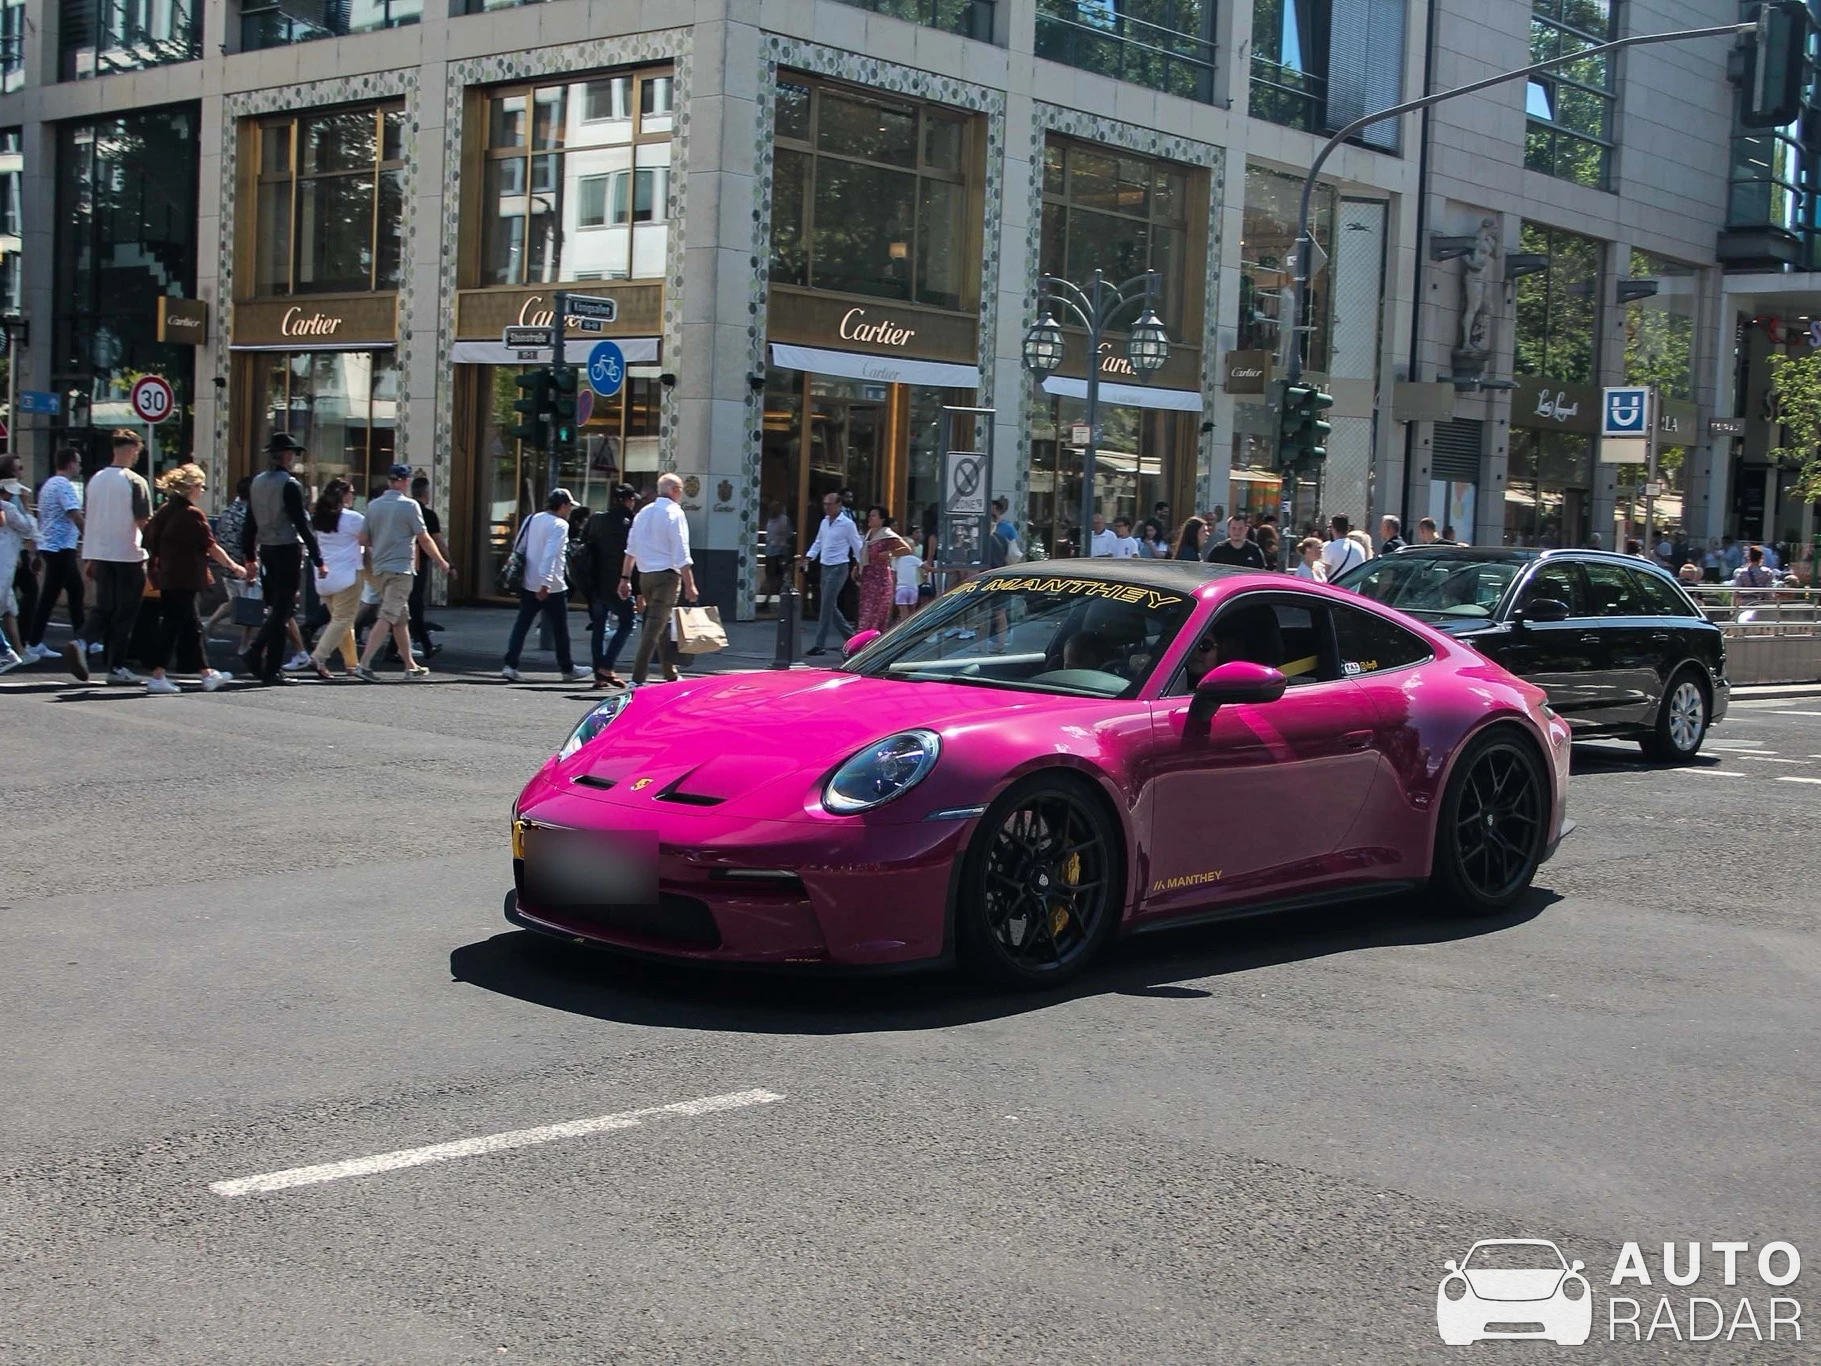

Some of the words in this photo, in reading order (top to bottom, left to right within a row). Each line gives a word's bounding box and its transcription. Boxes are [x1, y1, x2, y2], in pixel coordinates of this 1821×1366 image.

[167, 315, 201, 328] Cartier
[281, 307, 342, 336] Cartier
[519, 296, 580, 328] Care
[839, 307, 916, 346] Cartier
[861, 360, 901, 381] Cartier
[1231, 366, 1263, 377] Cartier
[140, 390, 165, 411] 30
[981, 578, 1182, 609] MANTHEY
[1167, 870, 1223, 888] MANTHEY
